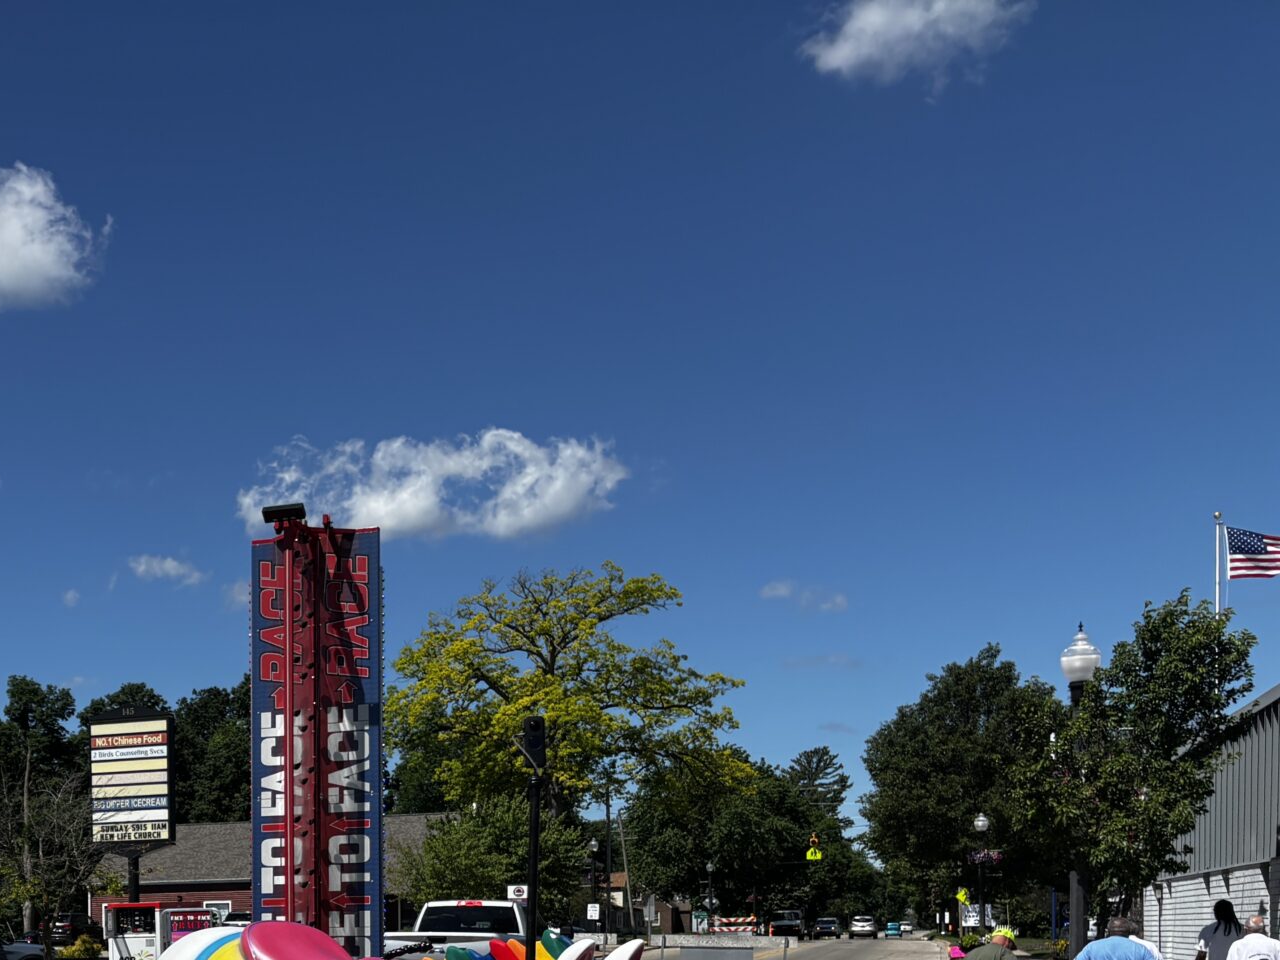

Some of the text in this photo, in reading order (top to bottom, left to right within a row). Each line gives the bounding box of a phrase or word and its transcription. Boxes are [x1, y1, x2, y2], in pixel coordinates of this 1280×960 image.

[326, 554, 369, 677] RACE
[113, 736, 141, 745] Chinese
[143, 734, 162, 743] Food
[115, 749, 148, 757] Counseling
[327, 704, 370, 813] FACE
[106, 800, 129, 808] DIPPER
[131, 798, 166, 807] ICECREAM
[134, 831, 161, 839] CHURCH
[328, 834, 370, 892] TO
